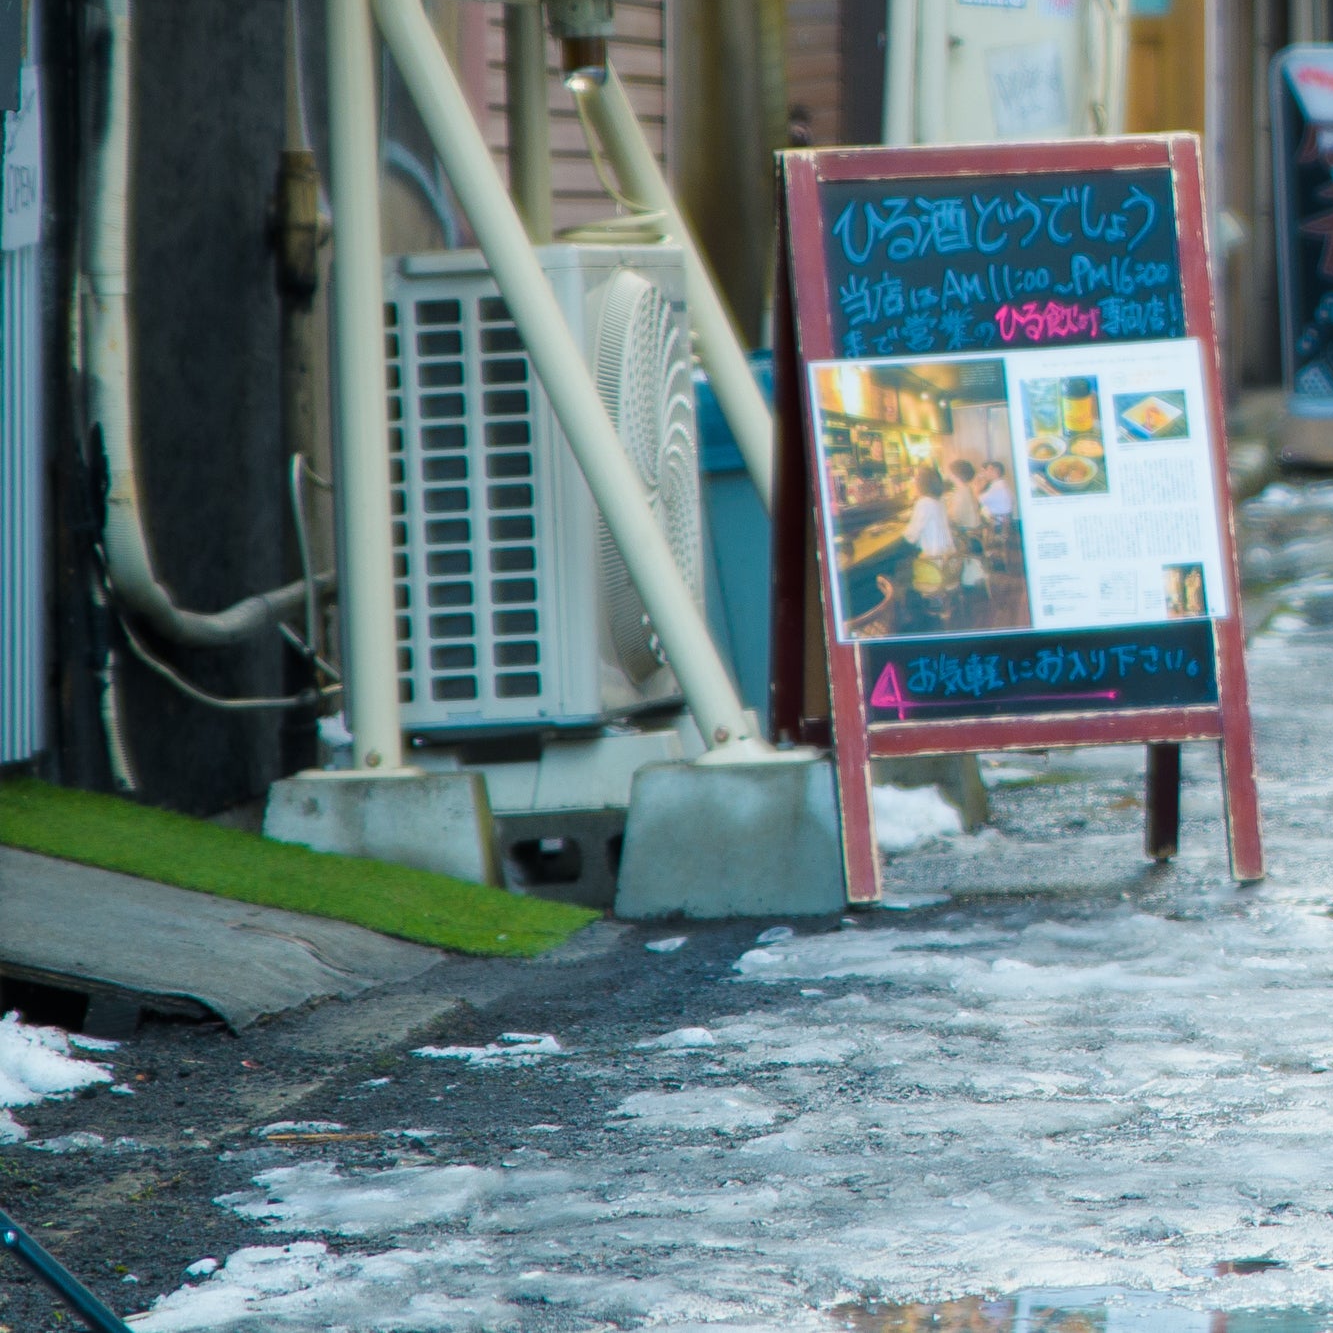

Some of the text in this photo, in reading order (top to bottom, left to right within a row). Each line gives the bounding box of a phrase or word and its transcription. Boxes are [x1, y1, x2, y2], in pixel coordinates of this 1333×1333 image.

[832, 184, 1157, 266] ひる酒どうでしょう
